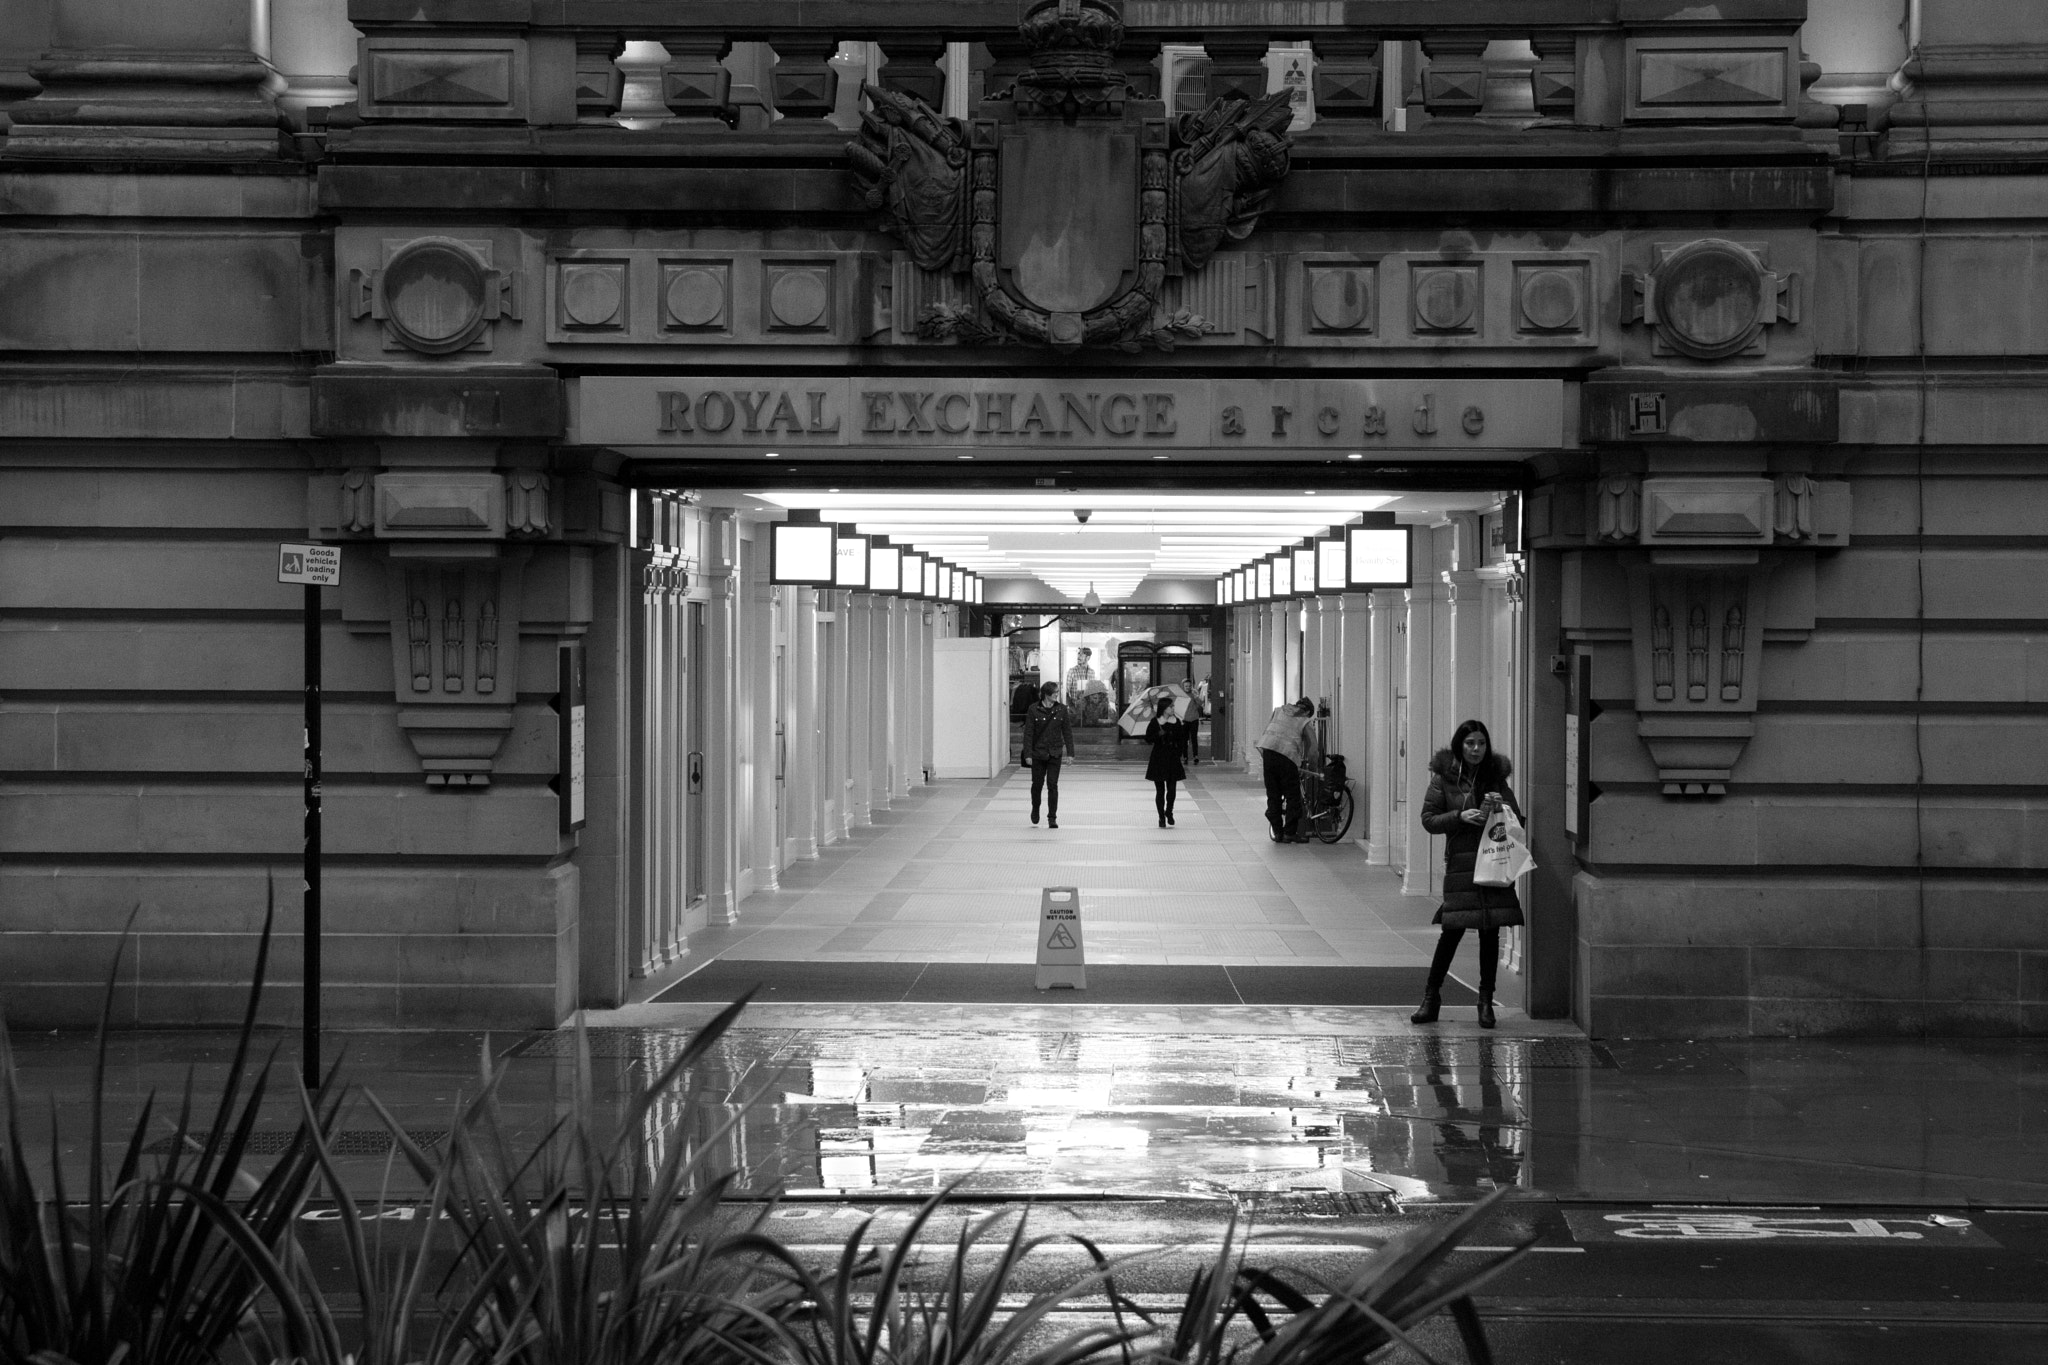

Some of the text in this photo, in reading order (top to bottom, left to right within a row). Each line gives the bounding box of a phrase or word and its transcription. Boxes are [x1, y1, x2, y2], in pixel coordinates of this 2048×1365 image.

[656, 390, 1485, 435] ROYAL EXCHANGE arcade
[309, 548, 334, 556] Goods
[305, 557, 338, 565] vehicles
[306, 565, 336, 574] loading
